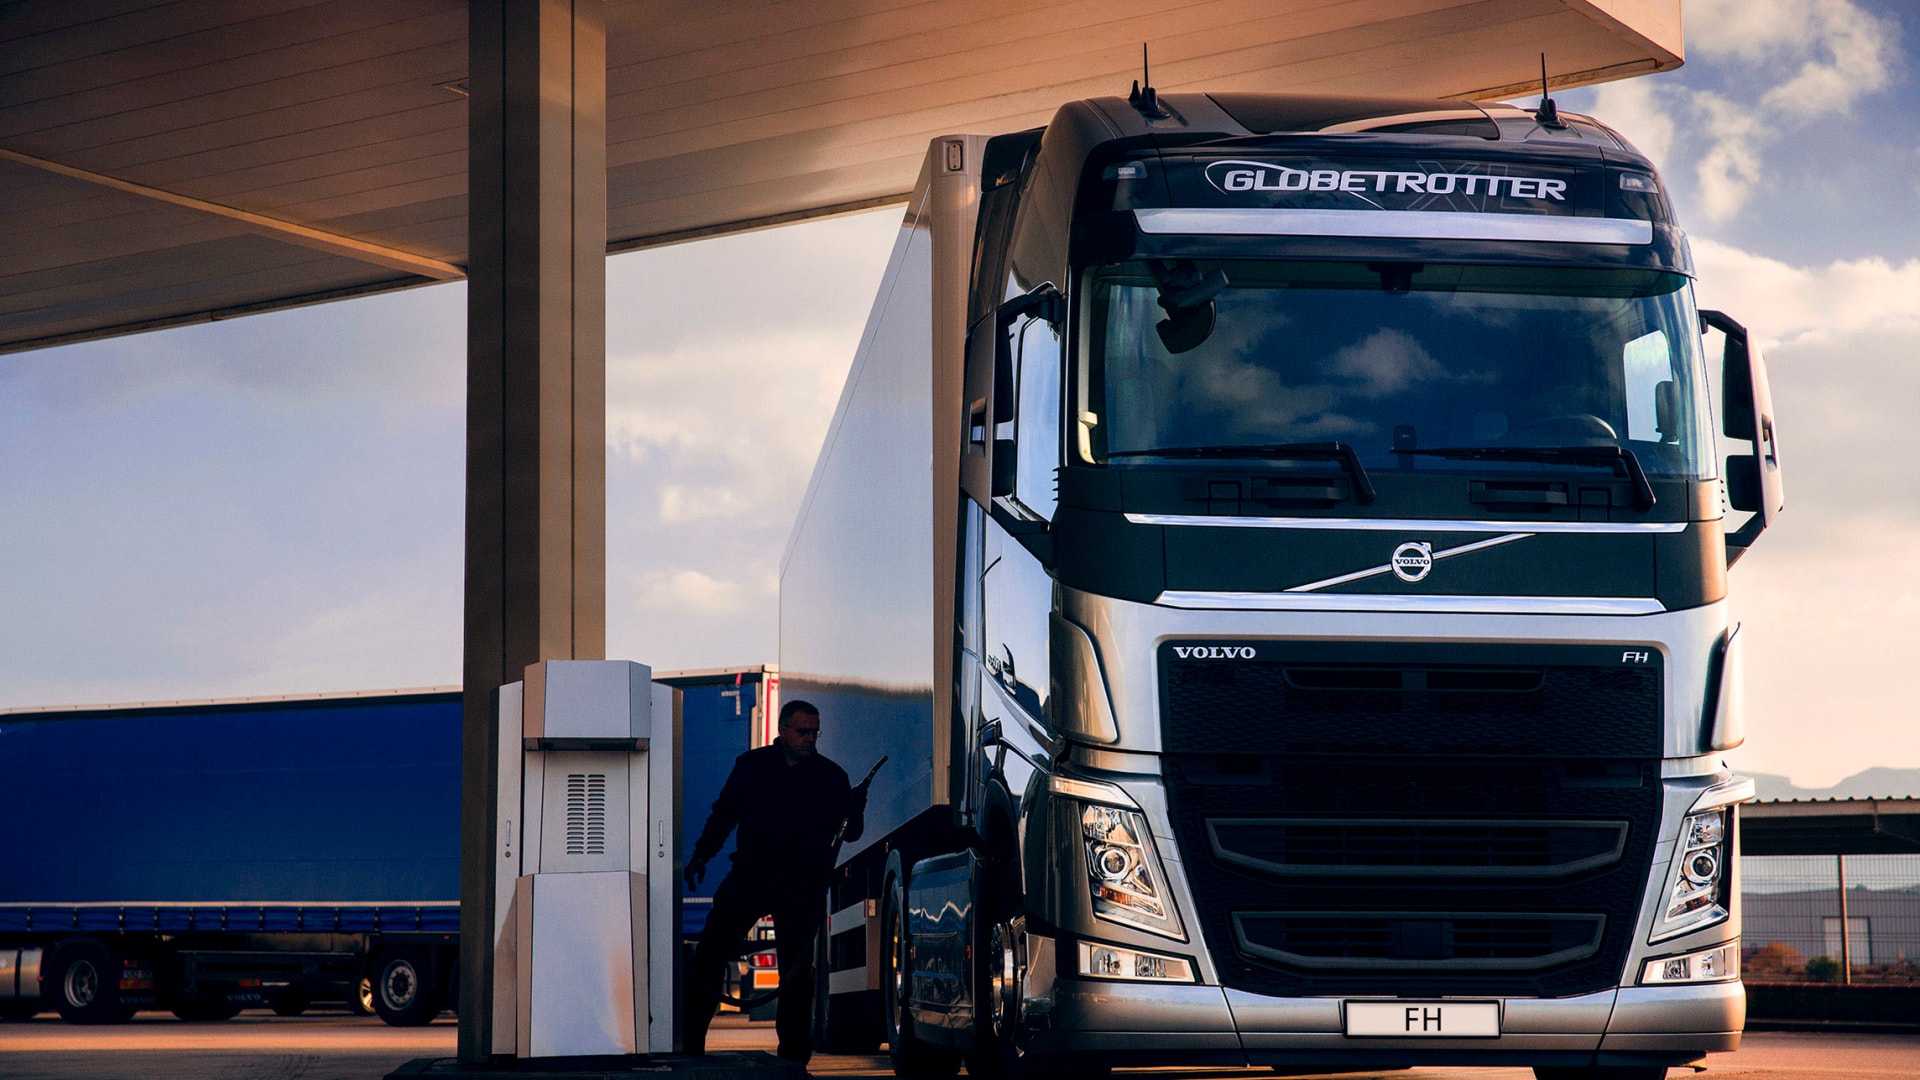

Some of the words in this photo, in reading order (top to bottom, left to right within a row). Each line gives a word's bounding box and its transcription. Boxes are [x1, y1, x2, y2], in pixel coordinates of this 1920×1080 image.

[1223, 170, 1567, 200] GLOBETROTTER
[1172, 646, 1256, 659] VOLVO
[1622, 651, 1649, 664] FH
[227, 993, 261, 1001] VOLVO
[1405, 1007, 1442, 1032] FH
